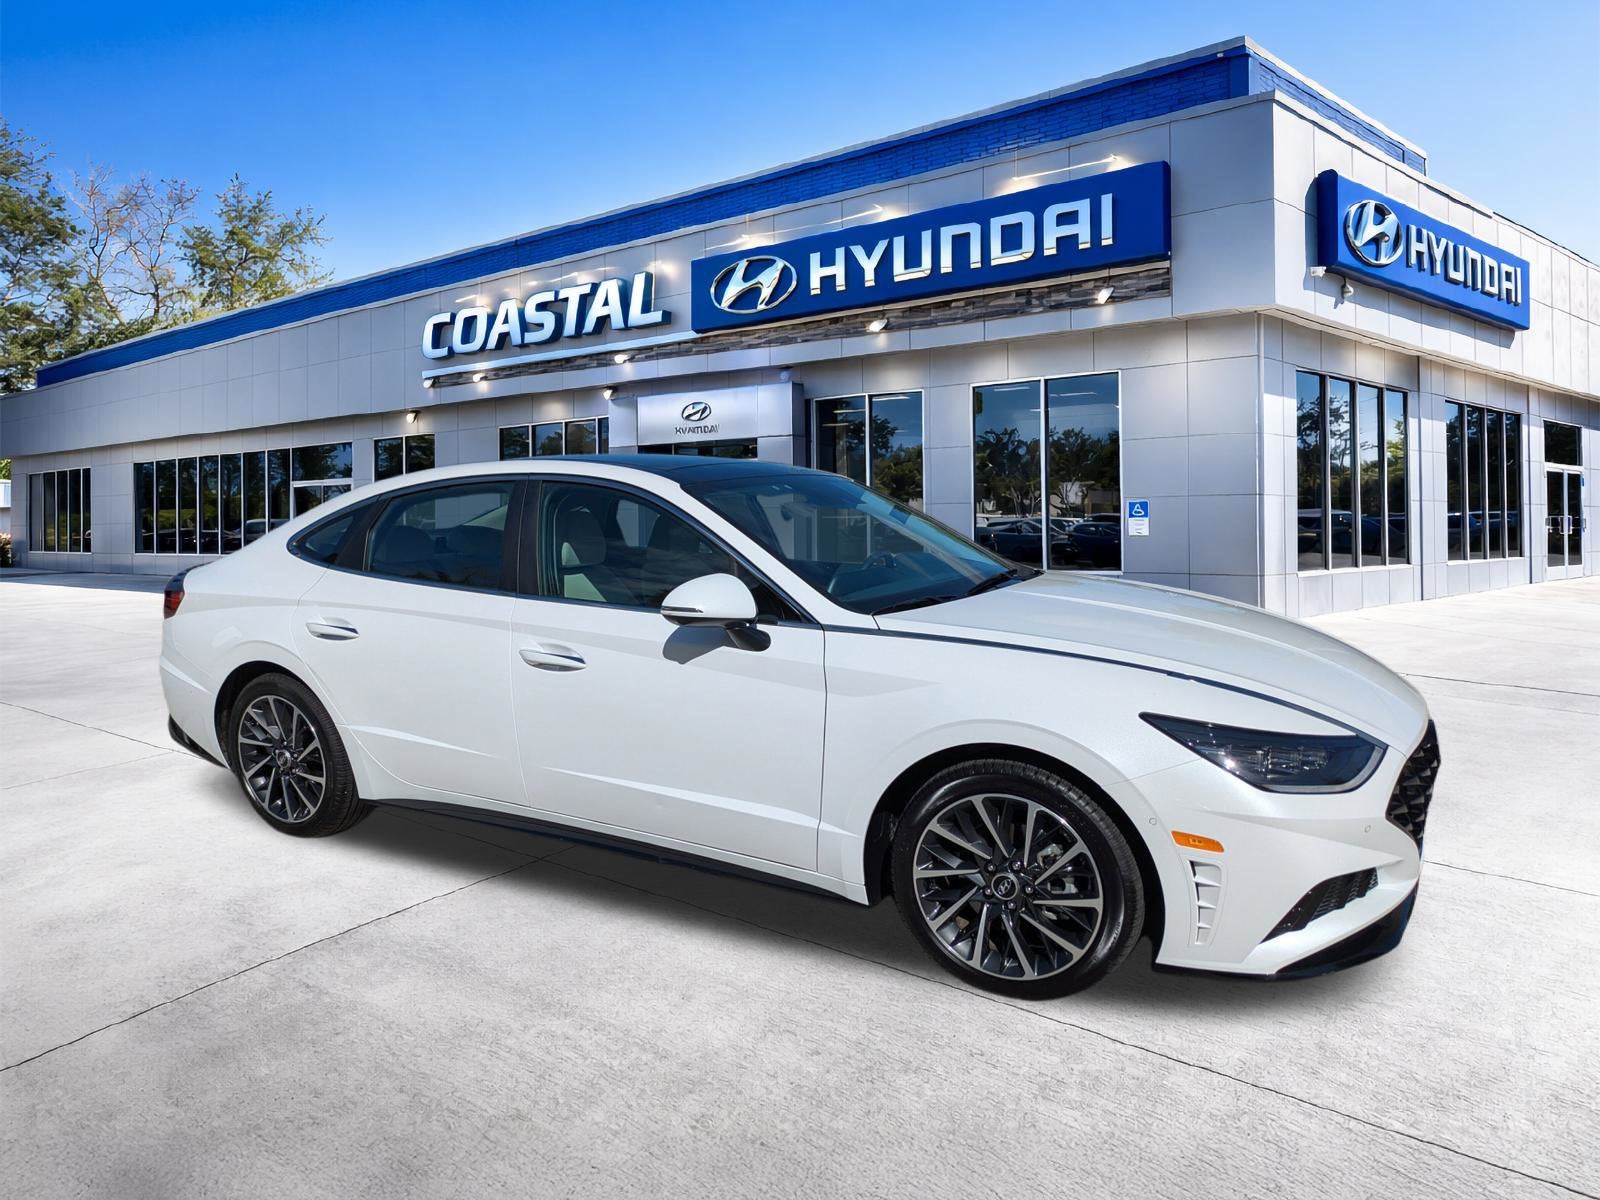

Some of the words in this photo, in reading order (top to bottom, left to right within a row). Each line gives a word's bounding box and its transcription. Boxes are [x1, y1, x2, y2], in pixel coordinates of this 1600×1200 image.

[809, 193, 1114, 295] HYUNDAI
[1406, 224, 1522, 306] HYUNDAI
[422, 271, 671, 359] COASTAL
